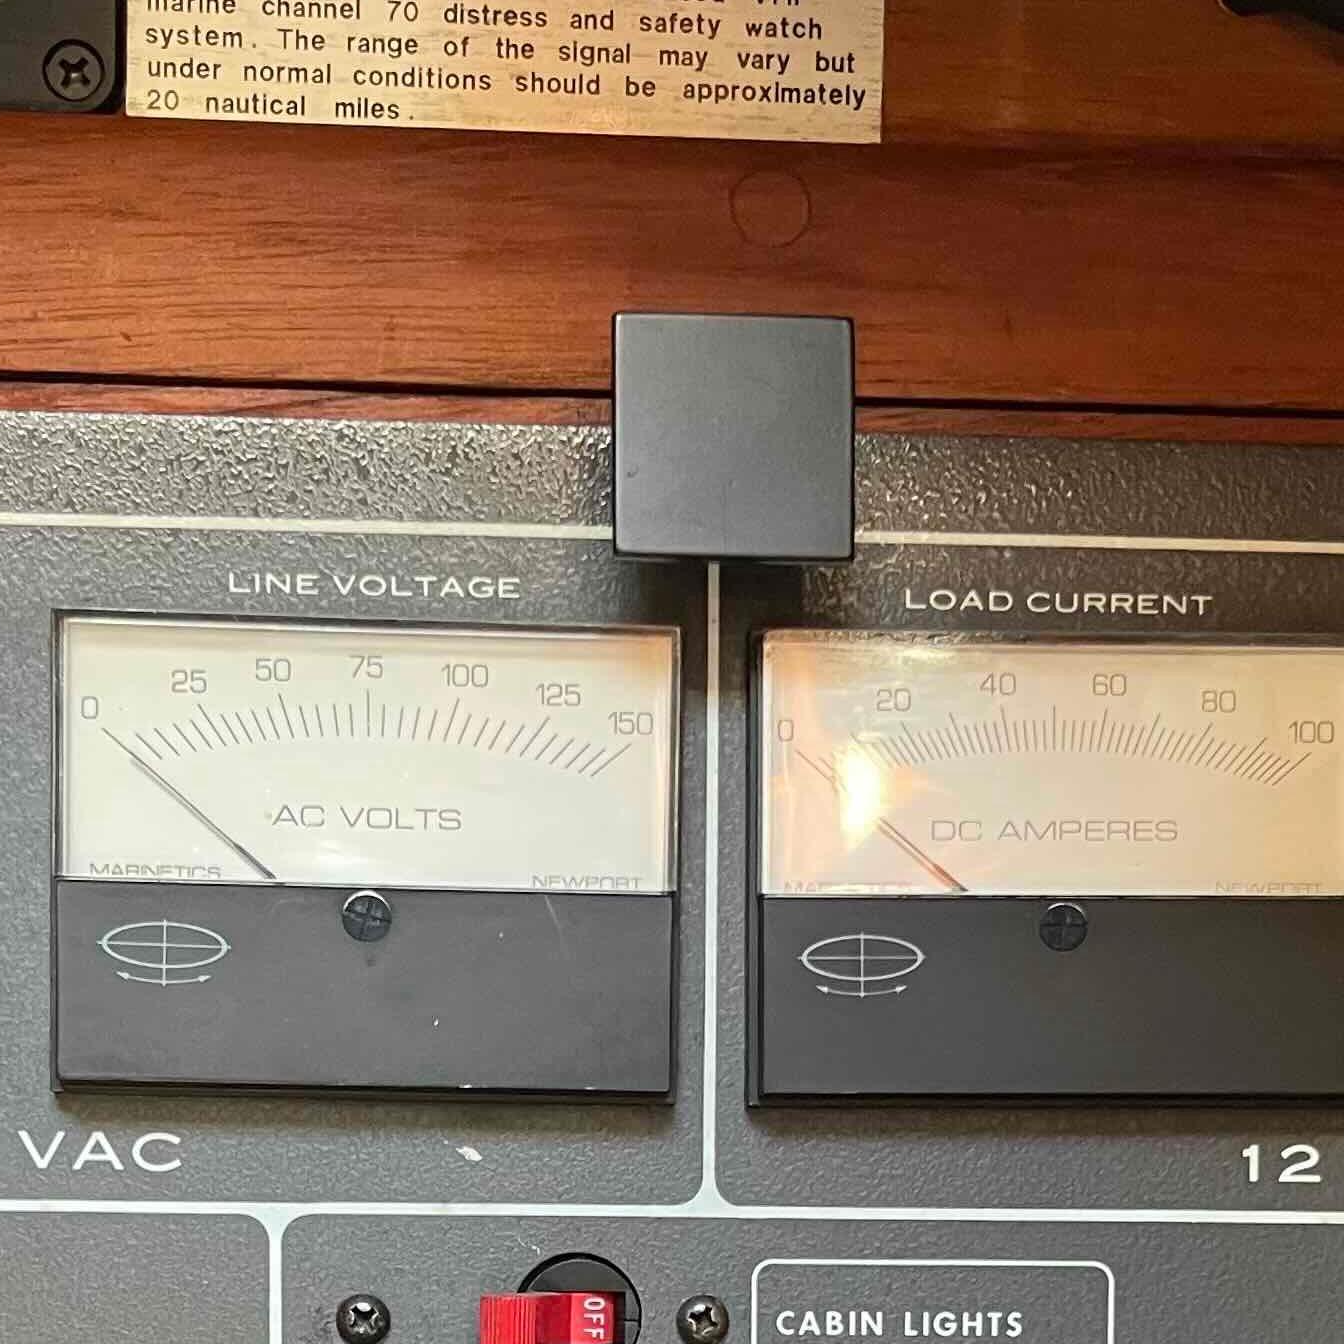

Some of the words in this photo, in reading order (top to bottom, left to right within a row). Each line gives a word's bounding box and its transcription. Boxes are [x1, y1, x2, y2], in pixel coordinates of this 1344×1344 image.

[262, 0, 361, 20] channel
[388, 1, 419, 22] 70
[443, 3, 548, 27] distress
[570, 10, 614, 31] and
[639, 13, 721, 40] safety
[746, 17, 822, 40] watch
[277, 28, 325, 50] The
[347, 35, 419, 58] range
[443, 36, 470, 57] of
[496, 38, 534, 59] the
[559, 41, 631, 66] signal
[659, 50, 708, 71] may
[737, 51, 790, 75] vary
[815, 51, 855, 74] but
[146, 90, 180, 111] 20
[205, 94, 306, 117] nautical
[148, 58, 222, 80] under
[244, 63, 331, 85] normal
[353, 67, 492, 91] conditions
[515, 72, 600, 96] should
[625, 76, 656, 97] be
[683, 81, 866, 111] approximately
[228, 572, 319, 595] LINE
[333, 574, 521, 599] VOLTAGE
[904, 589, 1013, 613] LOAD
[1026, 592, 1213, 616] CURRENT
[80, 696, 99, 720] 0
[171, 669, 207, 694] 25
[254, 658, 292, 683] 50
[351, 655, 383, 679] 75
[442, 664, 489, 688] 100
[535, 683, 581, 707] 125
[608, 712, 653, 735] 150
[776, 720, 795, 742] 0
[876, 689, 911, 712] 20
[980, 673, 1016, 697] 40
[1091, 674, 1127, 697] 60
[1202, 690, 1237, 714] 80
[1288, 722, 1335, 744] 100
[271, 804, 324, 828] AC
[339, 805, 462, 831] VOLTS
[931, 820, 982, 842] DC
[998, 820, 1179, 843] AMPERES
[17, 1131, 182, 1173] VAC
[1242, 1145, 1321, 1183] 12
[583, 1296, 605, 1341] OFF
[775, 1311, 884, 1337] CABIN
[903, 1311, 1023, 1337] LIGHTS
